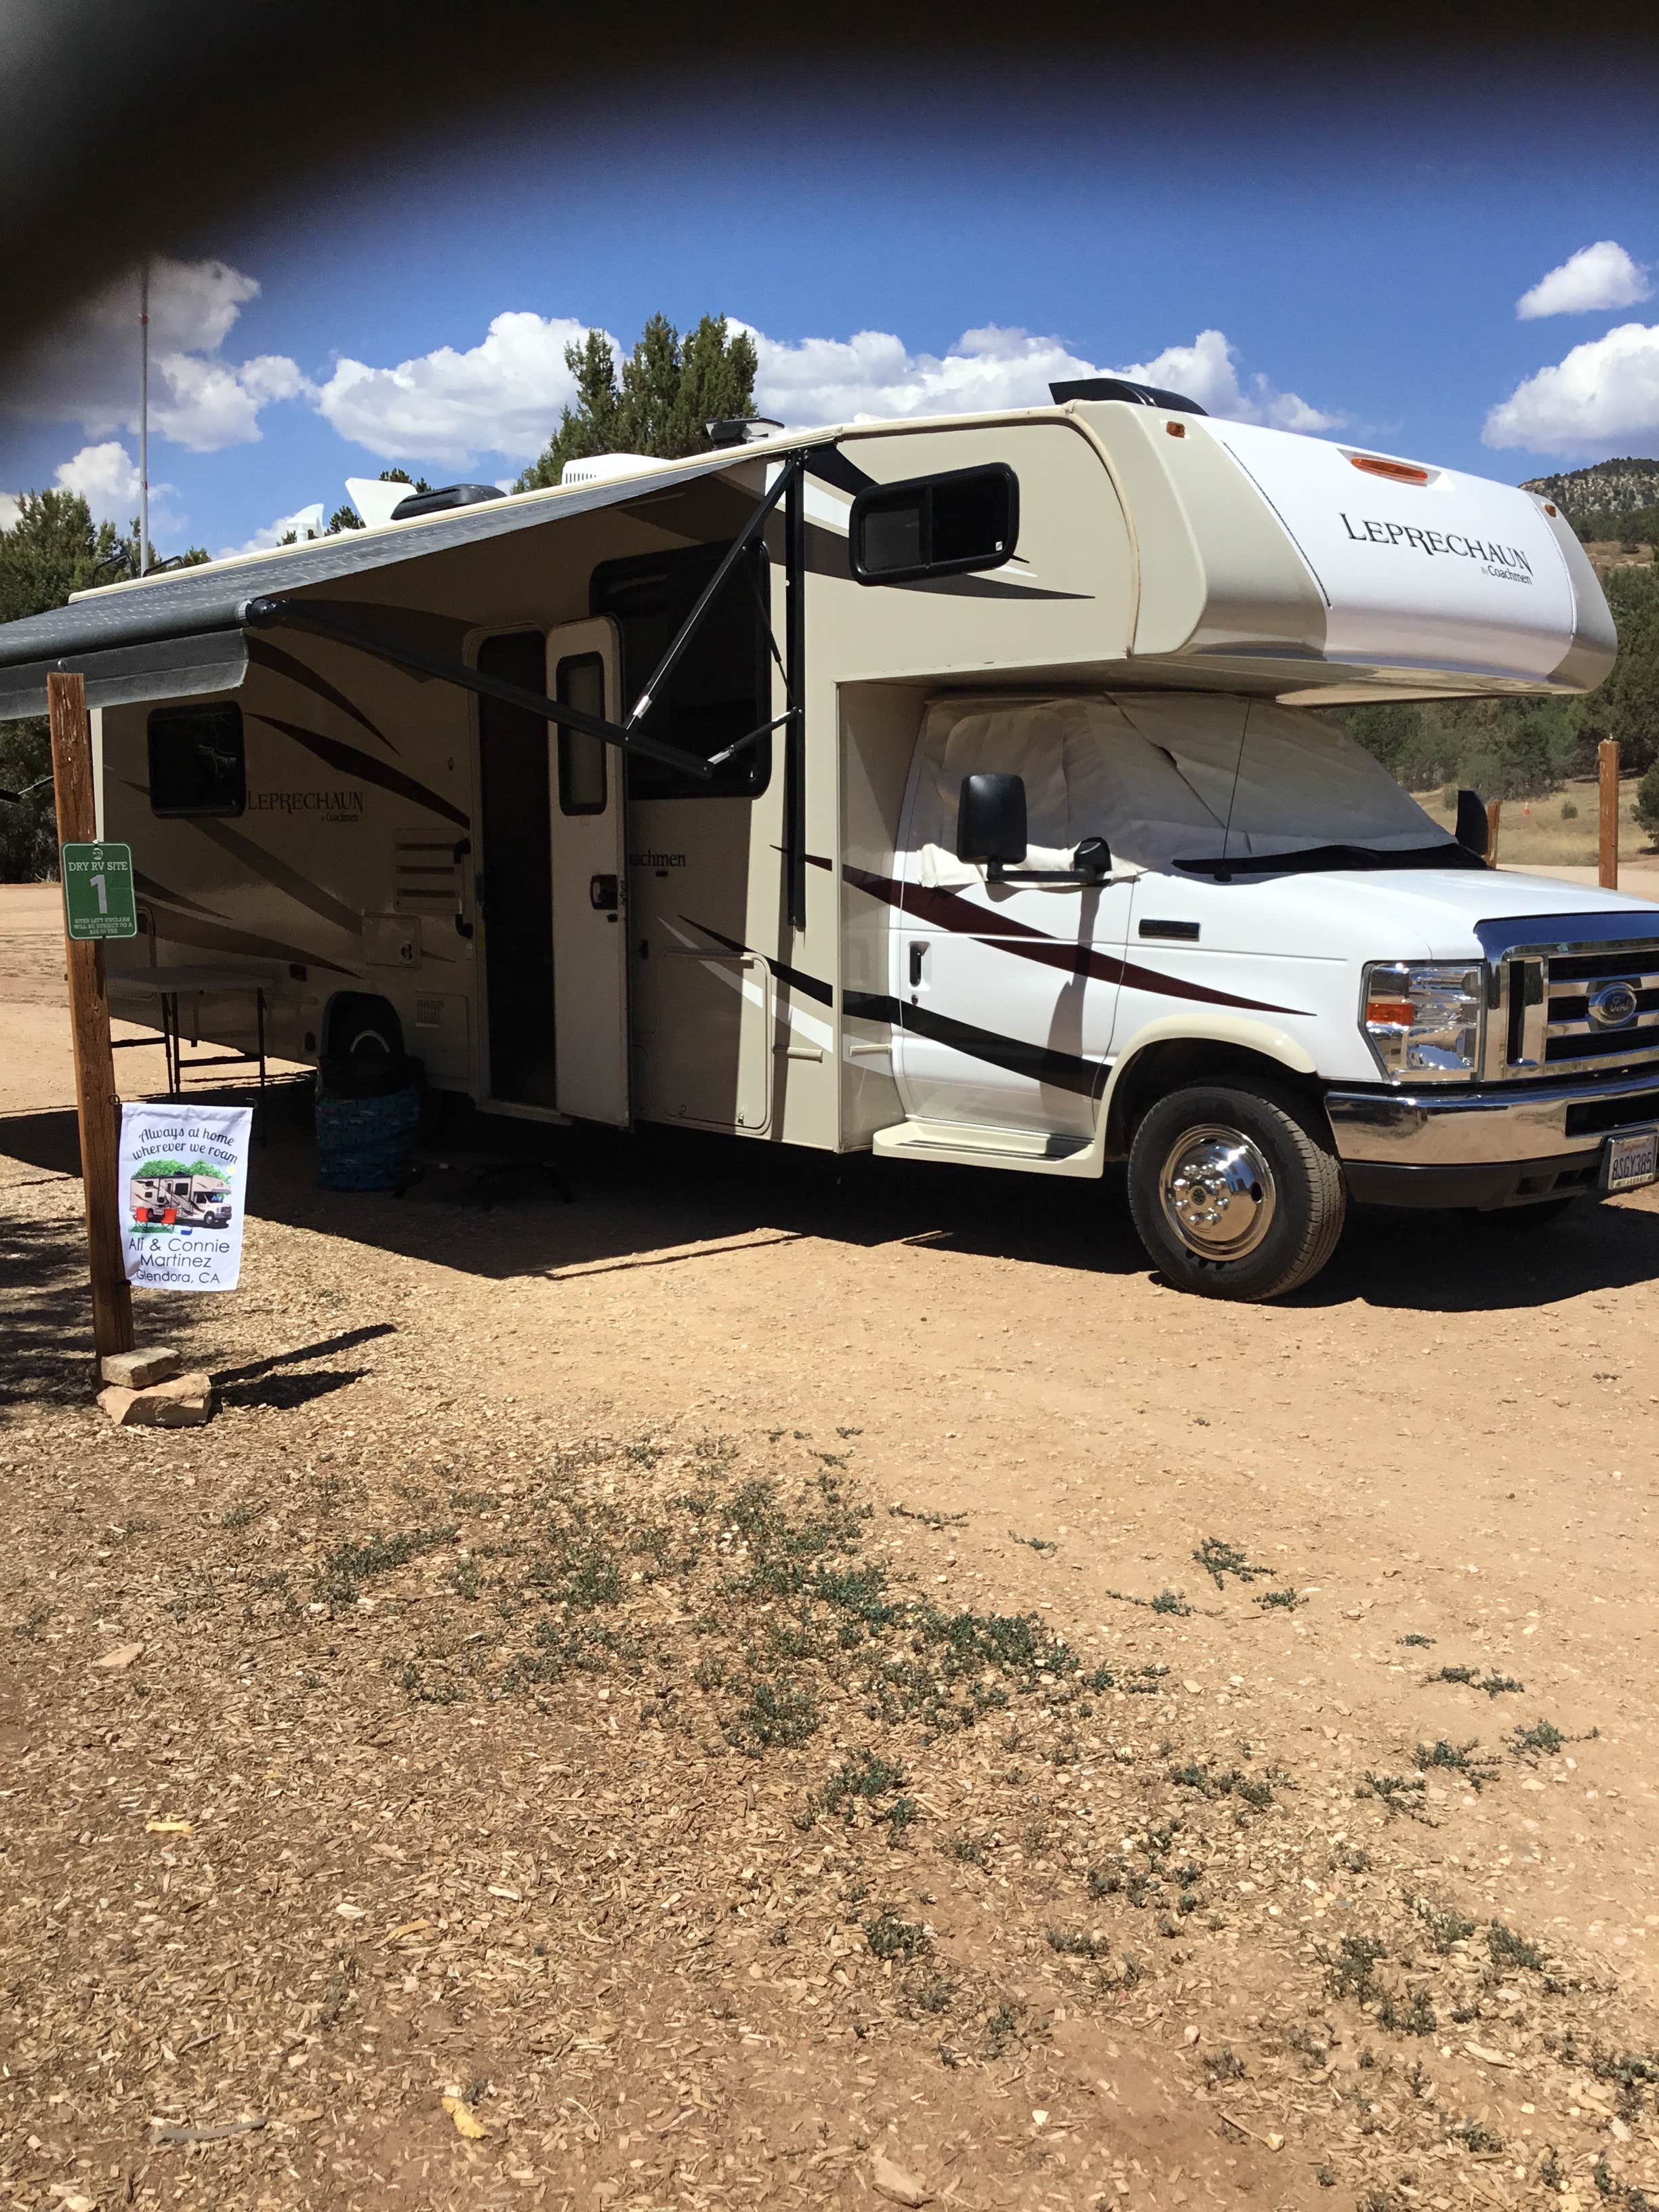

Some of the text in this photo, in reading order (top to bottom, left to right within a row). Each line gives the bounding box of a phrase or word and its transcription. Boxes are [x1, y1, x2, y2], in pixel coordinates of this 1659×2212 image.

[1488, 565, 1532, 585] Coachmen
[68, 861, 129, 872] DRY RV SITE
[89, 874, 108, 914] 1
[1610, 996, 1629, 1012] Ford
[139, 1128, 234, 1146] Always at home
[132, 1143, 238, 1164] wherever we roam
[1613, 1151, 1652, 1181] 8SGY385
[129, 1237, 230, 1253] Ali & Connie
[140, 1253, 212, 1268] Martinez
[136, 1269, 221, 1284] Glendora, CA
